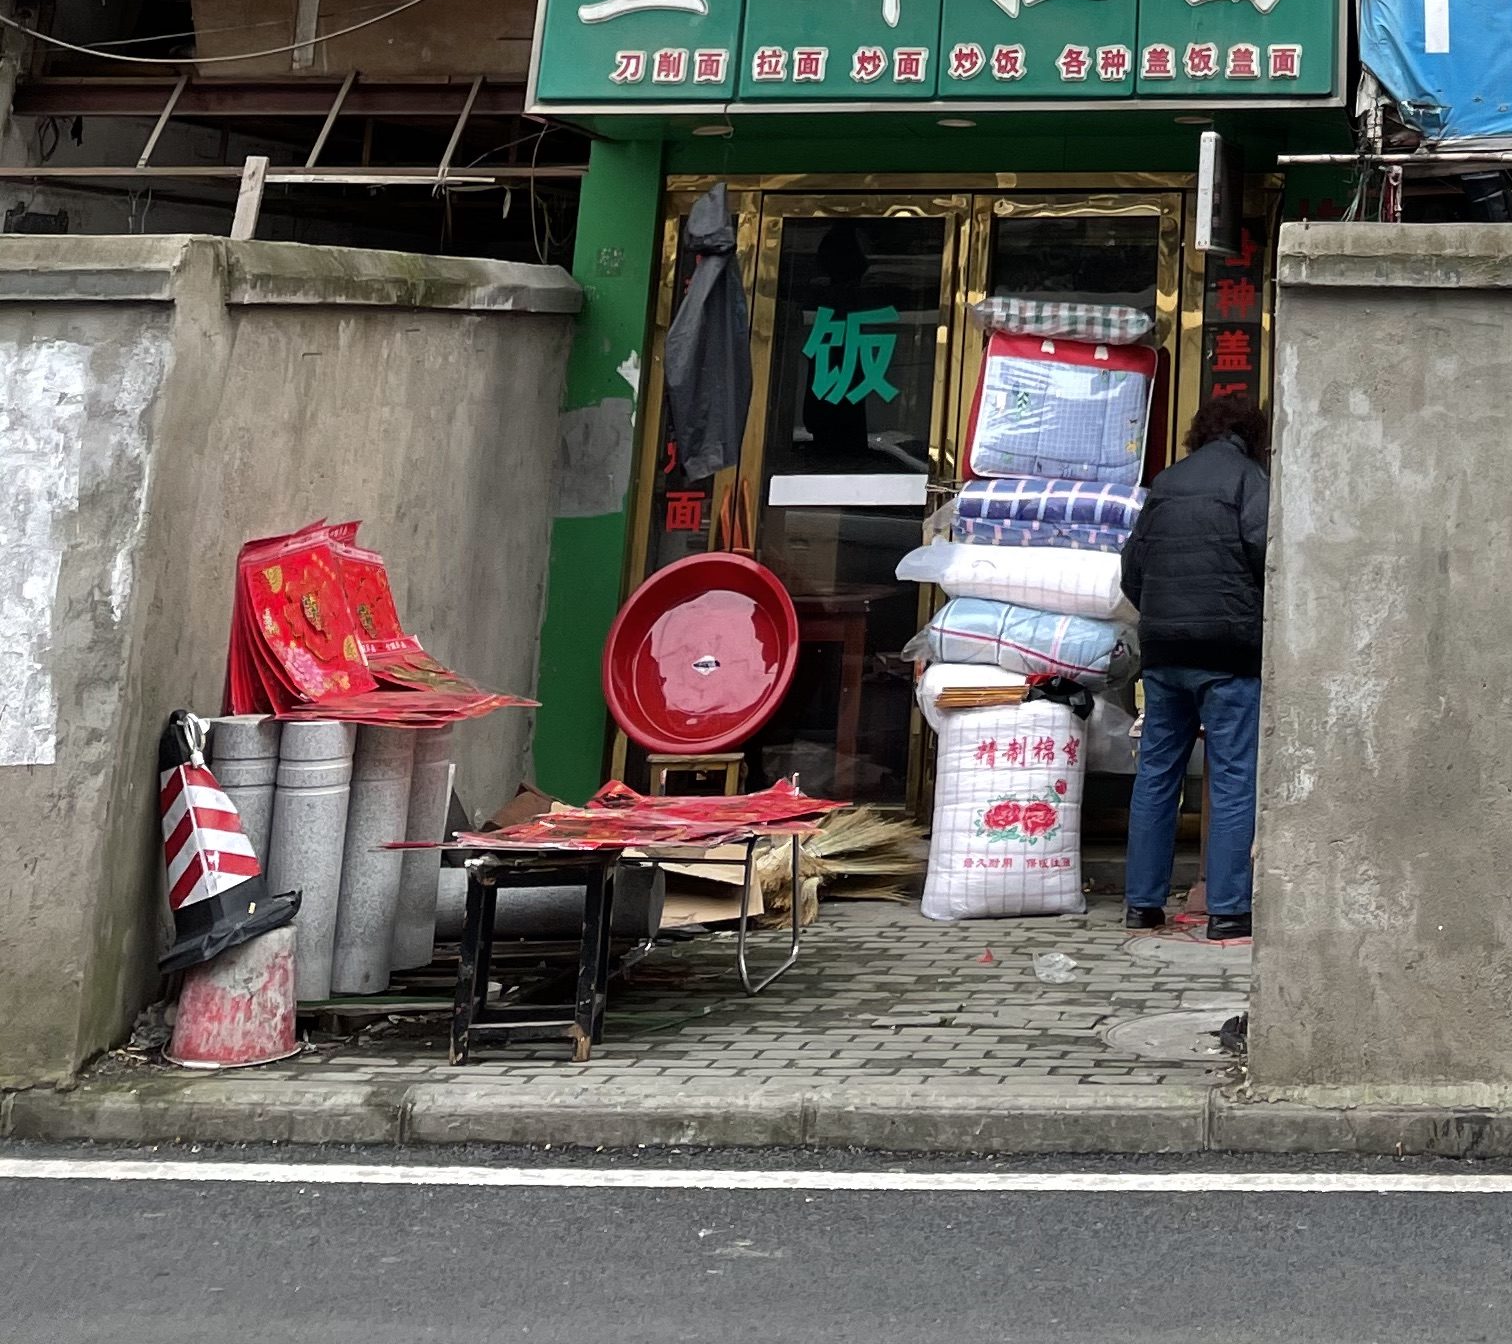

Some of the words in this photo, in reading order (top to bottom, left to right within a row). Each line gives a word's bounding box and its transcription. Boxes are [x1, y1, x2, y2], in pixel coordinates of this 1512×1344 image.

[612, 50, 727, 83] 刀削面
[755, 47, 826, 81] 拉面
[852, 48, 926, 82] 炒面
[950, 44, 1025, 79] 炒饭
[1057, 44, 1299, 80] 各种盖饭盖面
[802, 305, 900, 405] 饭
